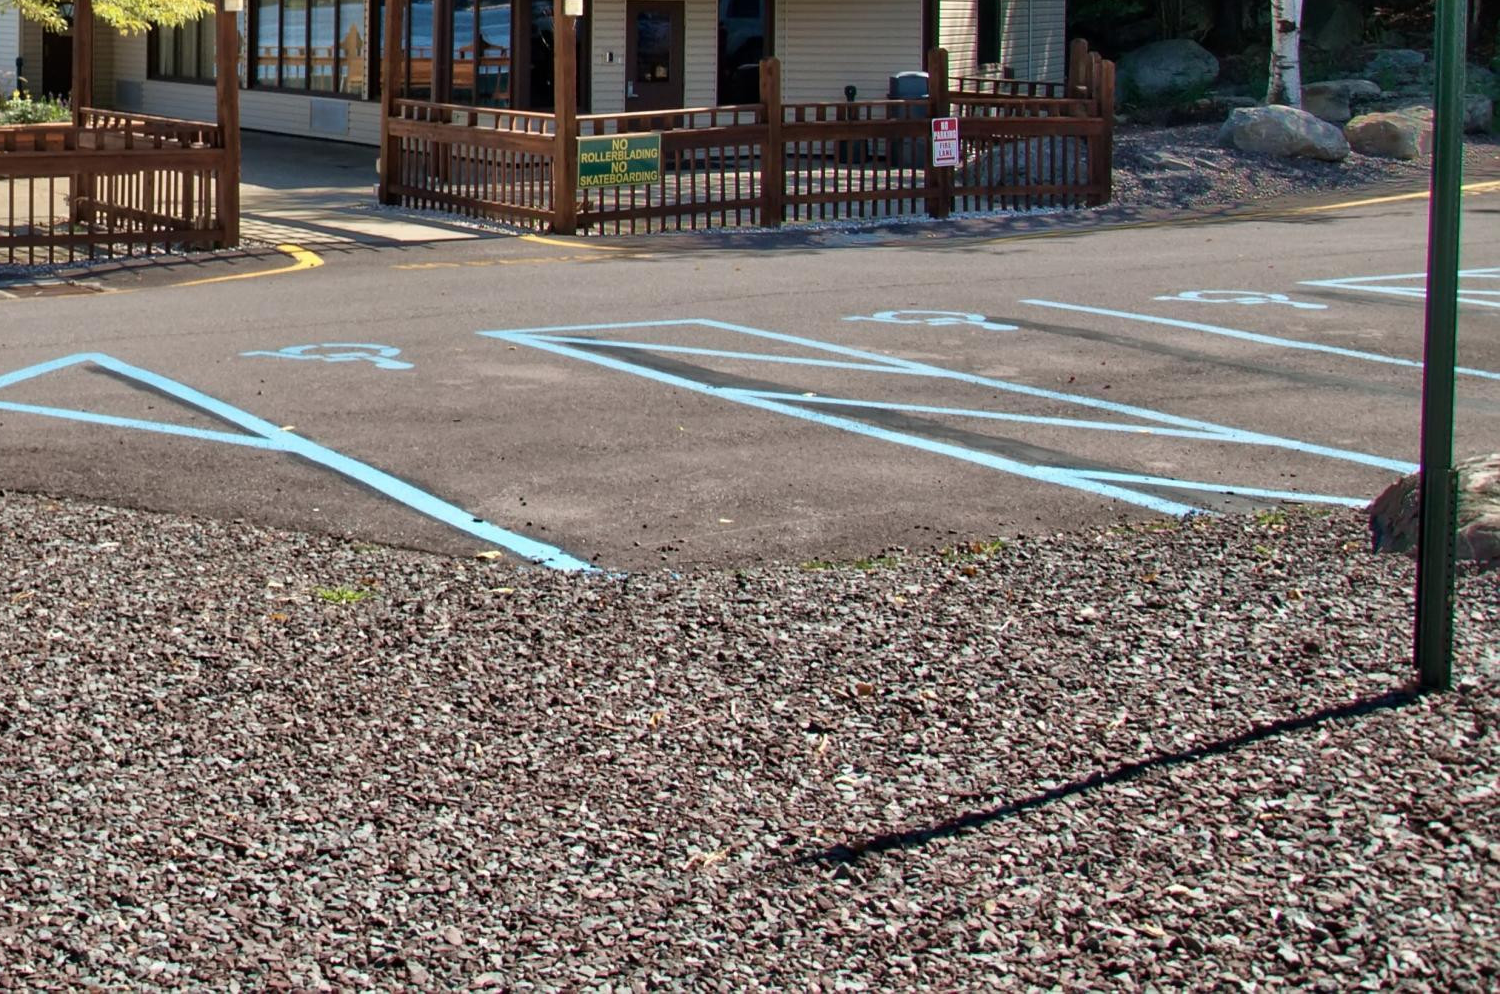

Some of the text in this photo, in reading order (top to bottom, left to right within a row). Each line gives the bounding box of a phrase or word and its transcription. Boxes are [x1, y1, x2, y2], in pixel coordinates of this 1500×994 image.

[612, 138, 628, 150] NO
[939, 142, 951, 150] FIRE
[581, 148, 658, 163] ROLLERBLADING
[938, 149, 953, 158] LANE
[611, 161, 627, 173] NO
[579, 170, 658, 186] SKATEBOARDING
